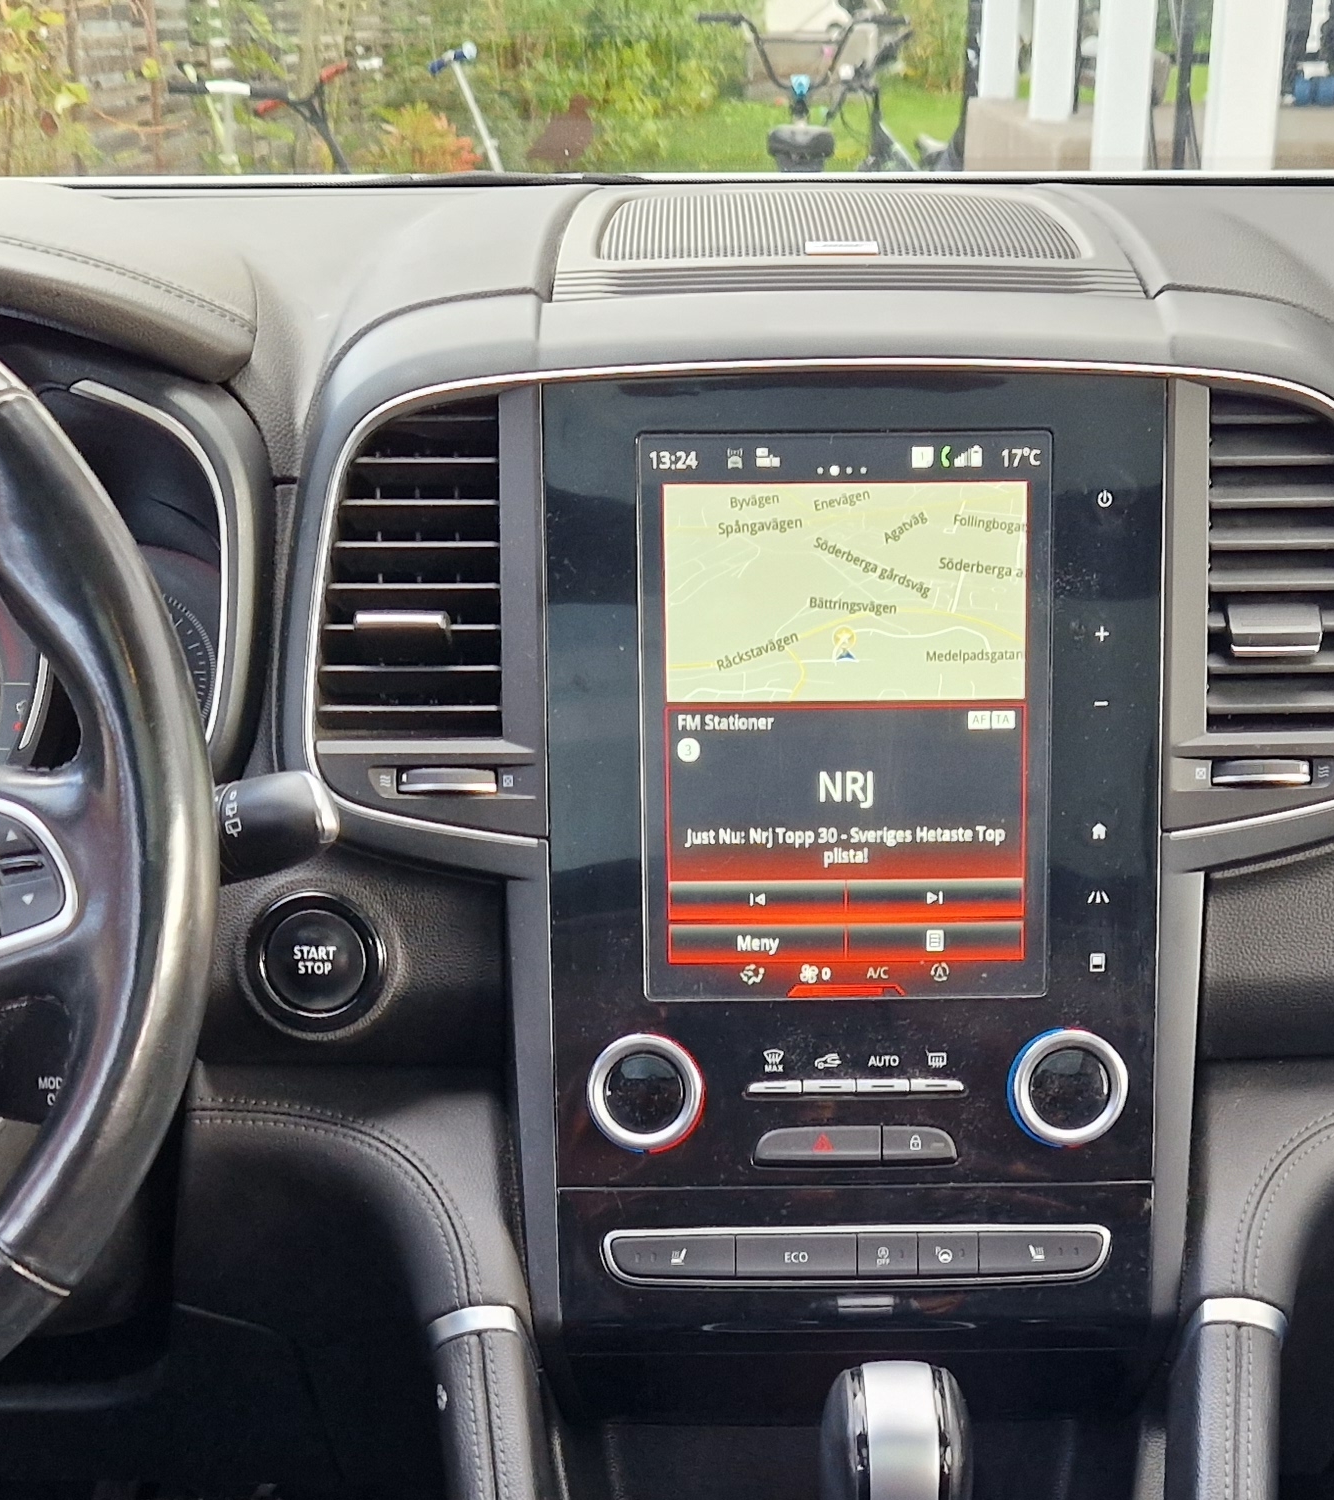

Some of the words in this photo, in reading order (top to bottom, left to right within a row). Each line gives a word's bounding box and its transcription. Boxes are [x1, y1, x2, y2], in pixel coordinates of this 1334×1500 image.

[649, 449, 698, 470] 13:24
[1001, 447, 1041, 468] 17°C
[730, 494, 779, 511] Byvägen
[814, 490, 870, 511] Enevägen
[718, 517, 803, 537] Spångavägen
[884, 511, 928, 544] Agatväg
[813, 537, 878, 573] Söderberga
[878, 568, 931, 599] gårdsväg
[938, 557, 1012, 579] Söderberga
[809, 596, 897, 616] Bättringsvägen
[716, 631, 799, 671] Råckstavägen
[925, 648, 1023, 664] Medelpadsgatan
[677, 714, 701, 731] FM
[704, 714, 775, 731] Stationer
[972, 713, 987, 726] AF
[995, 713, 1010, 726] TA
[819, 771, 875, 808] NRJ
[684, 828, 716, 848] Just
[719, 828, 746, 844] Nu:
[749, 827, 773, 848] Nrj
[775, 827, 815, 848] Topp
[818, 827, 838, 844] 30
[850, 826, 913, 847] Sveriges
[916, 826, 974, 843] Hetaste
[976, 825, 1006, 846] Top
[823, 847, 869, 868] plista!
[293, 944, 337, 960] START
[737, 934, 779, 955] Meny
[298, 960, 332, 975] STOP
[867, 966, 890, 979] A/C
[764, 1064, 784, 1073] MAX
[868, 1055, 900, 1067] AUTO
[38, 1076, 63, 1090] MOD
[784, 1252, 809, 1263] ECO
[876, 1258, 891, 1267] OFF
